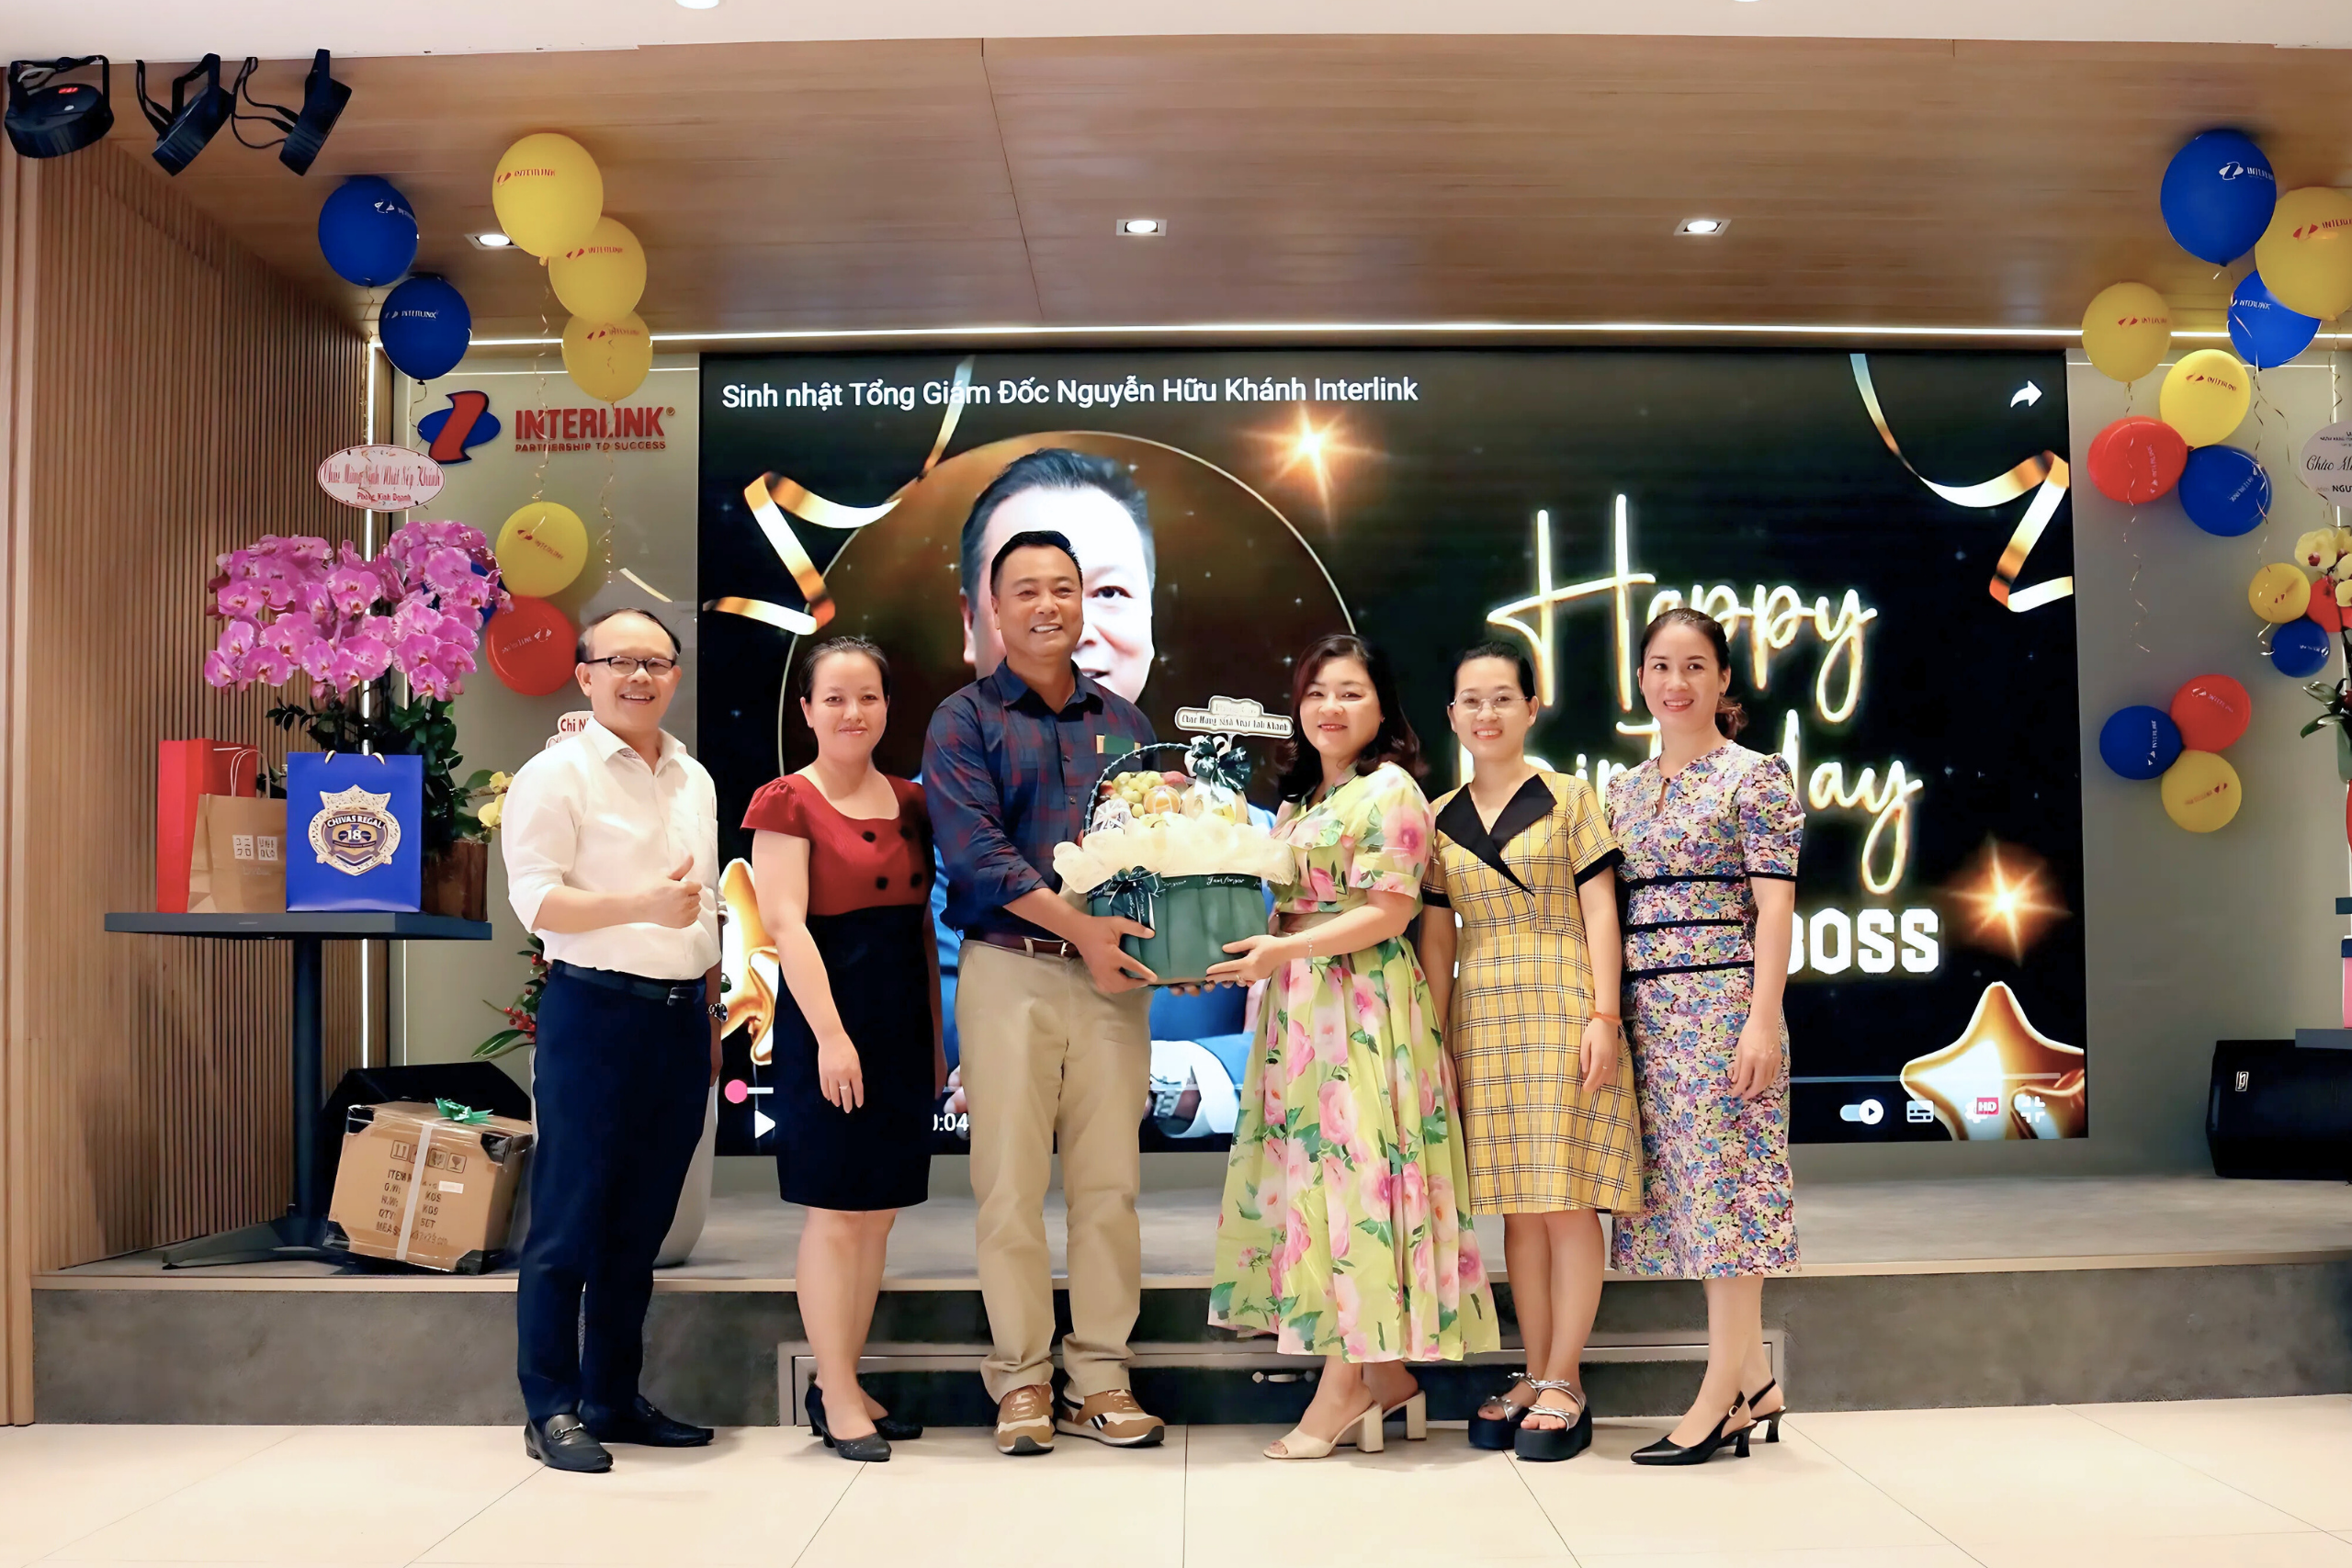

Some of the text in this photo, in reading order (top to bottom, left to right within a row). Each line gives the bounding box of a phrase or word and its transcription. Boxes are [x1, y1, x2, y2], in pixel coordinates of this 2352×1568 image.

[722, 375, 1419, 411] Sinh nhật Tổng Giám Đốc Nguyễn Hữu Khánh Interlink
[515, 407, 665, 440] INTERLINK
[515, 442, 592, 453] PARTNERSHIP
[615, 441, 666, 451] SUCCESS
[560, 718, 575, 732] Chi
[326, 815, 382, 829] CHIVAS REGAL
[346, 829, 361, 840] 18
[1977, 1101, 1997, 1112] HD
